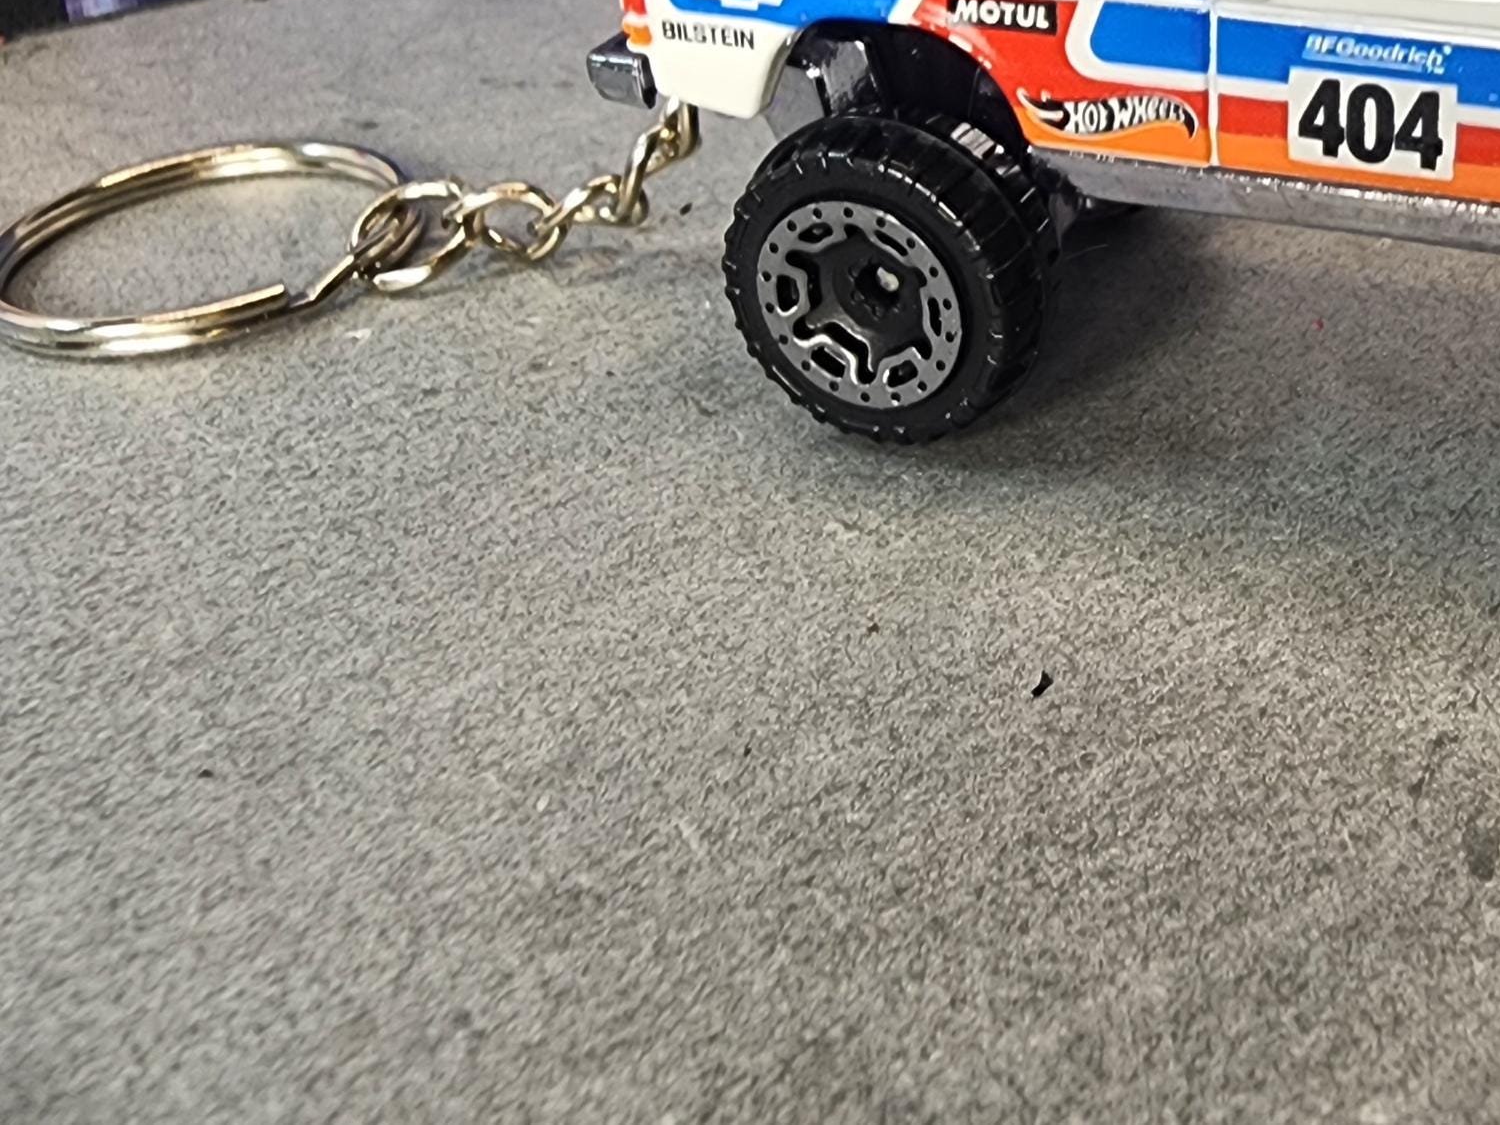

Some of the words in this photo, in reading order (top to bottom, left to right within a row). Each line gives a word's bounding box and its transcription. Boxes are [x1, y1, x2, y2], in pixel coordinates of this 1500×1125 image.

[662, 20, 755, 50] BILSTEIN
[1063, 101, 1109, 134] HOT
[1298, 77, 1443, 172] 404
